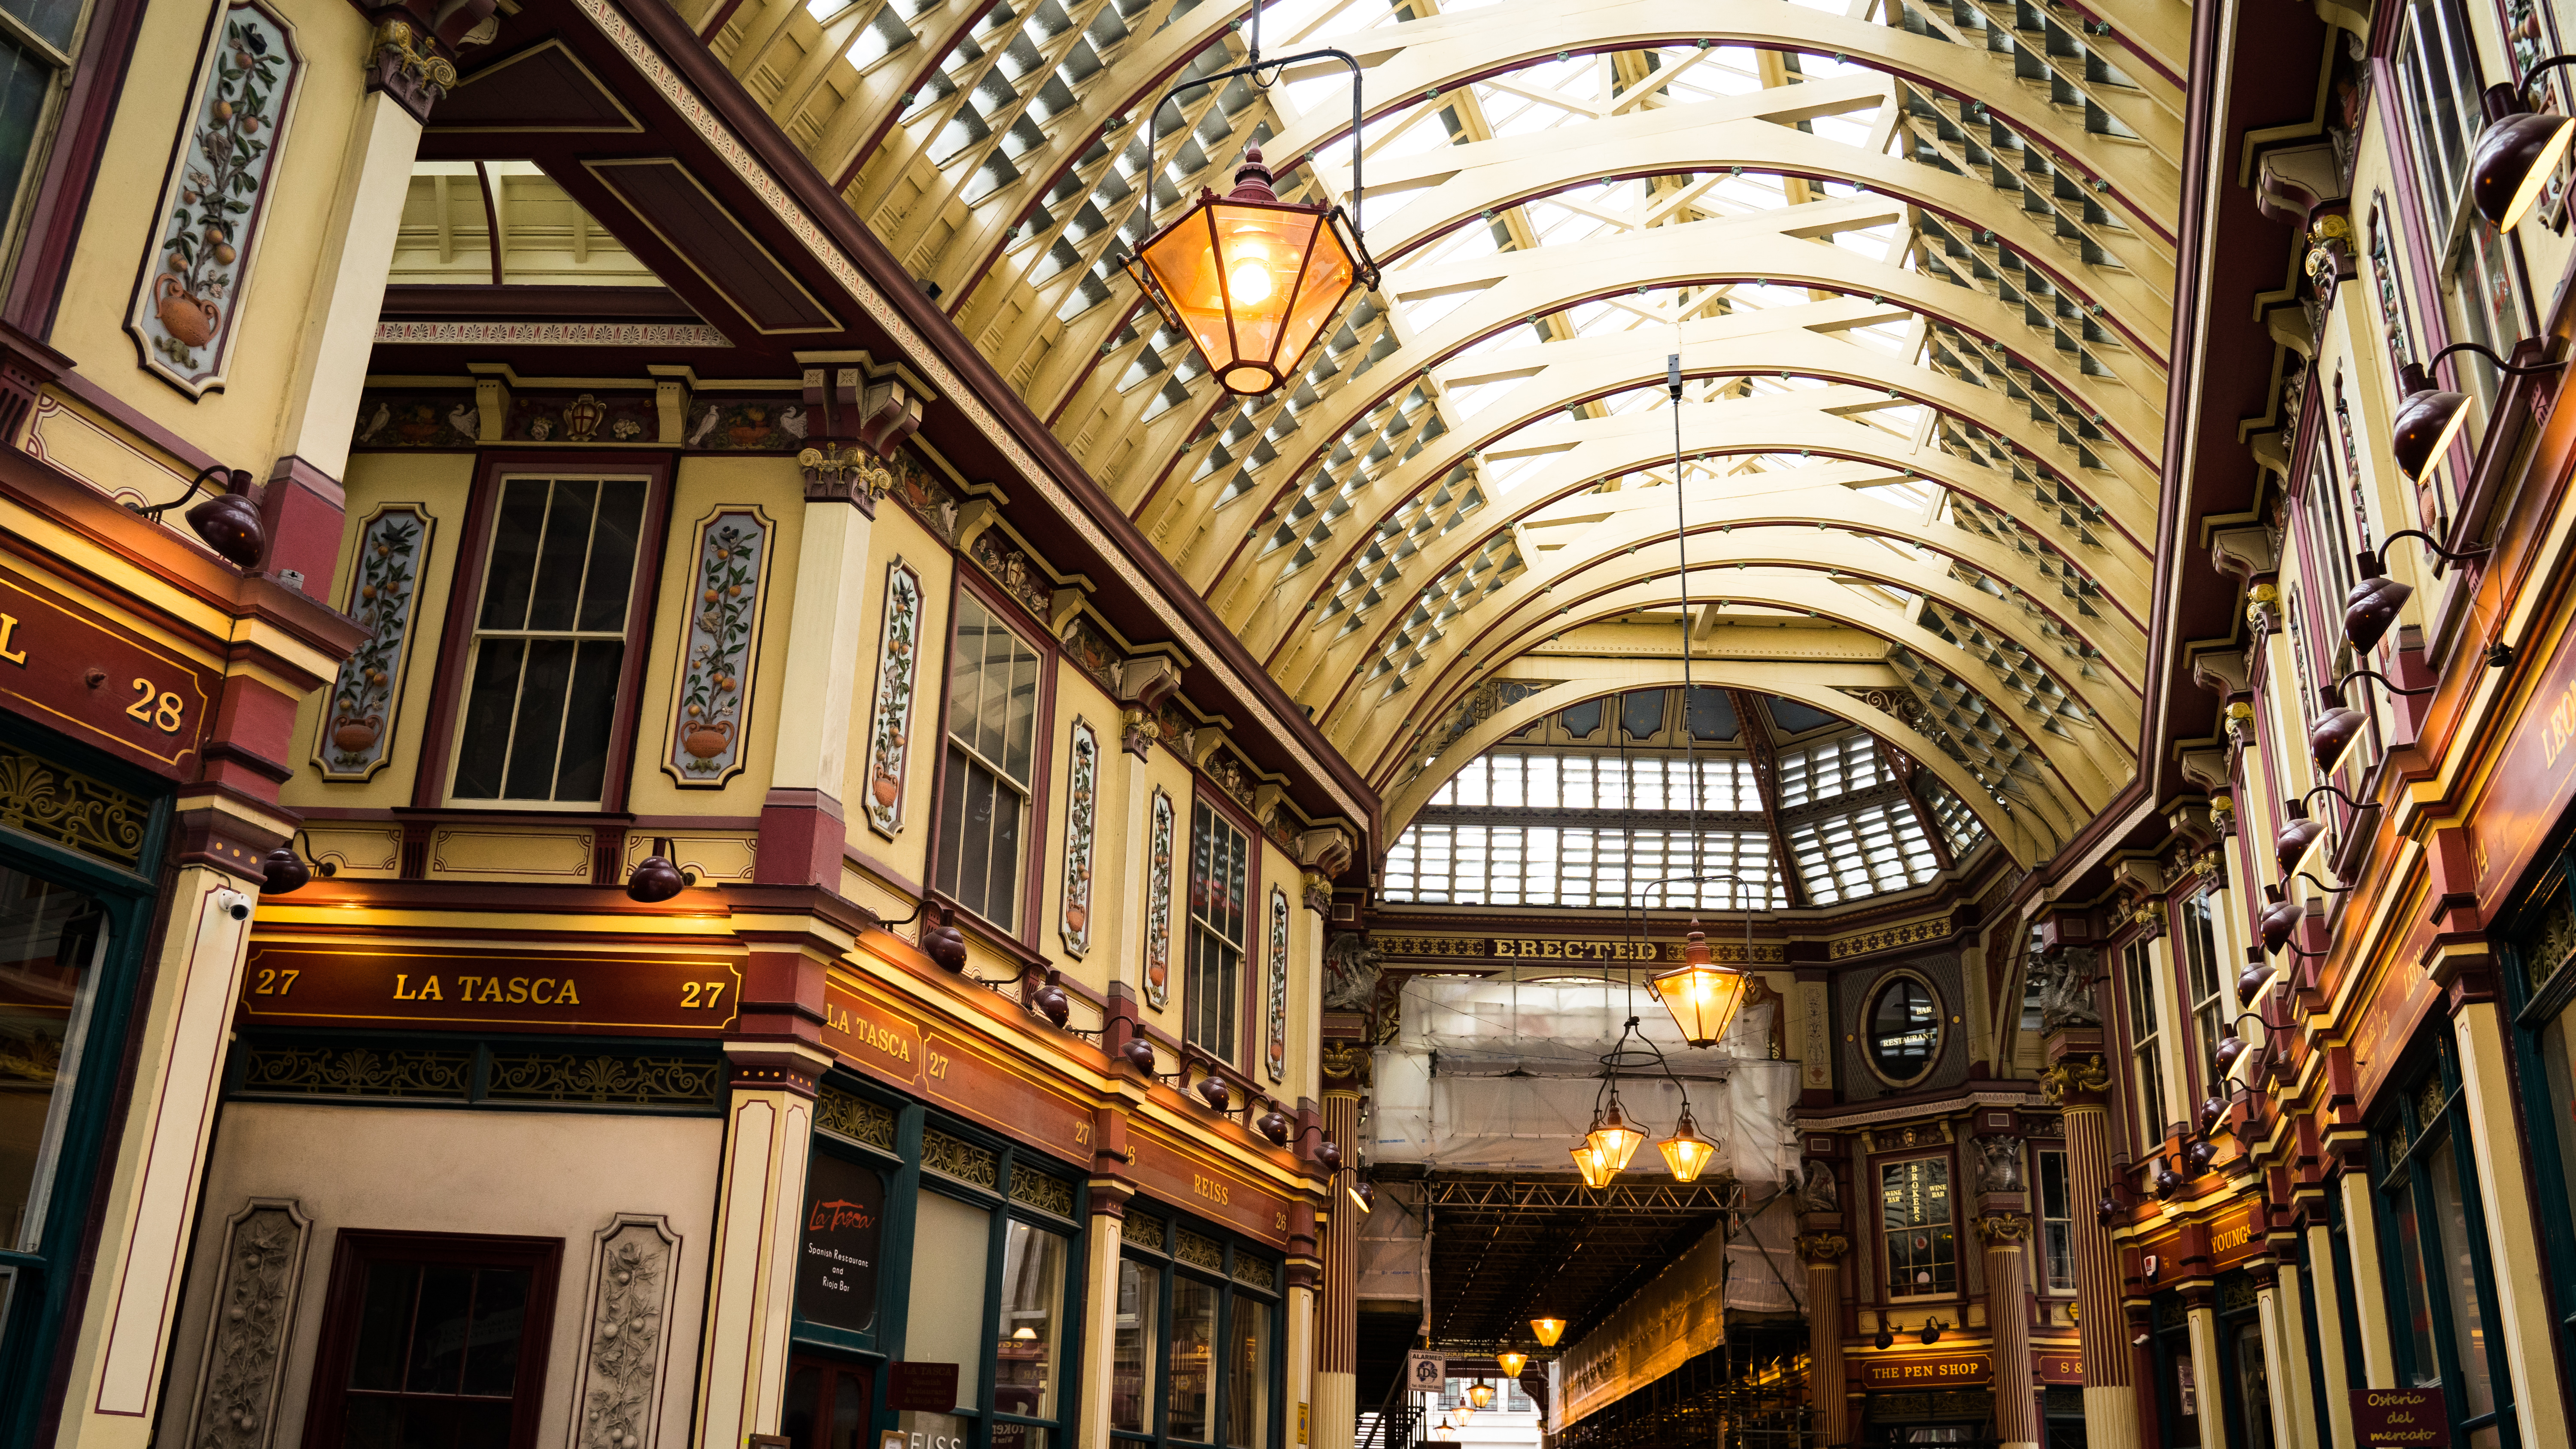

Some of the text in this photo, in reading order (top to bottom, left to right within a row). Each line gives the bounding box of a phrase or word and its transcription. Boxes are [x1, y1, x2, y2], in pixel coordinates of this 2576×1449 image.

[126, 677, 184, 732] 28
[2541, 673, 2576, 770] LEO
[2475, 838, 2489, 883] 14
[1494, 939, 1657, 960] ERECTED
[255, 969, 300, 995] 27
[394, 974, 580, 1005] LA TASCA
[681, 981, 726, 1008] 27
[1916, 1006, 1932, 1015] BAR
[827, 1003, 910, 1062] LA TASCA
[2382, 1010, 2389, 1041] 13
[1883, 1032, 1934, 1047] RESTAURANT
[929, 1051, 949, 1079] 27
[1075, 1121, 1090, 1145] 27
[1194, 1173, 1229, 1206] REISS
[1911, 1165, 1920, 1222] BROKERS
[809, 1199, 875, 1232] La Tasca
[1276, 1212, 1286, 1232] 26
[808, 1243, 869, 1267] Spanish Restaurant
[832, 1266, 843, 1275] and
[823, 1276, 850, 1292] Rioja Bar
[904, 1366, 952, 1376] LA TASCA
[1416, 1367, 1438, 1378] IDS
[1872, 1363, 1979, 1379] THE PEN SHOP
[2061, 1362, 2083, 1373] 8 &
[912, 1378, 941, 1387] Spanish
[2367, 1392, 2426, 1406] Osteria
[2387, 1411, 2415, 1424] del
[898, 1430, 961, 1449] EIS
[2370, 1428, 2436, 1441] mercato
